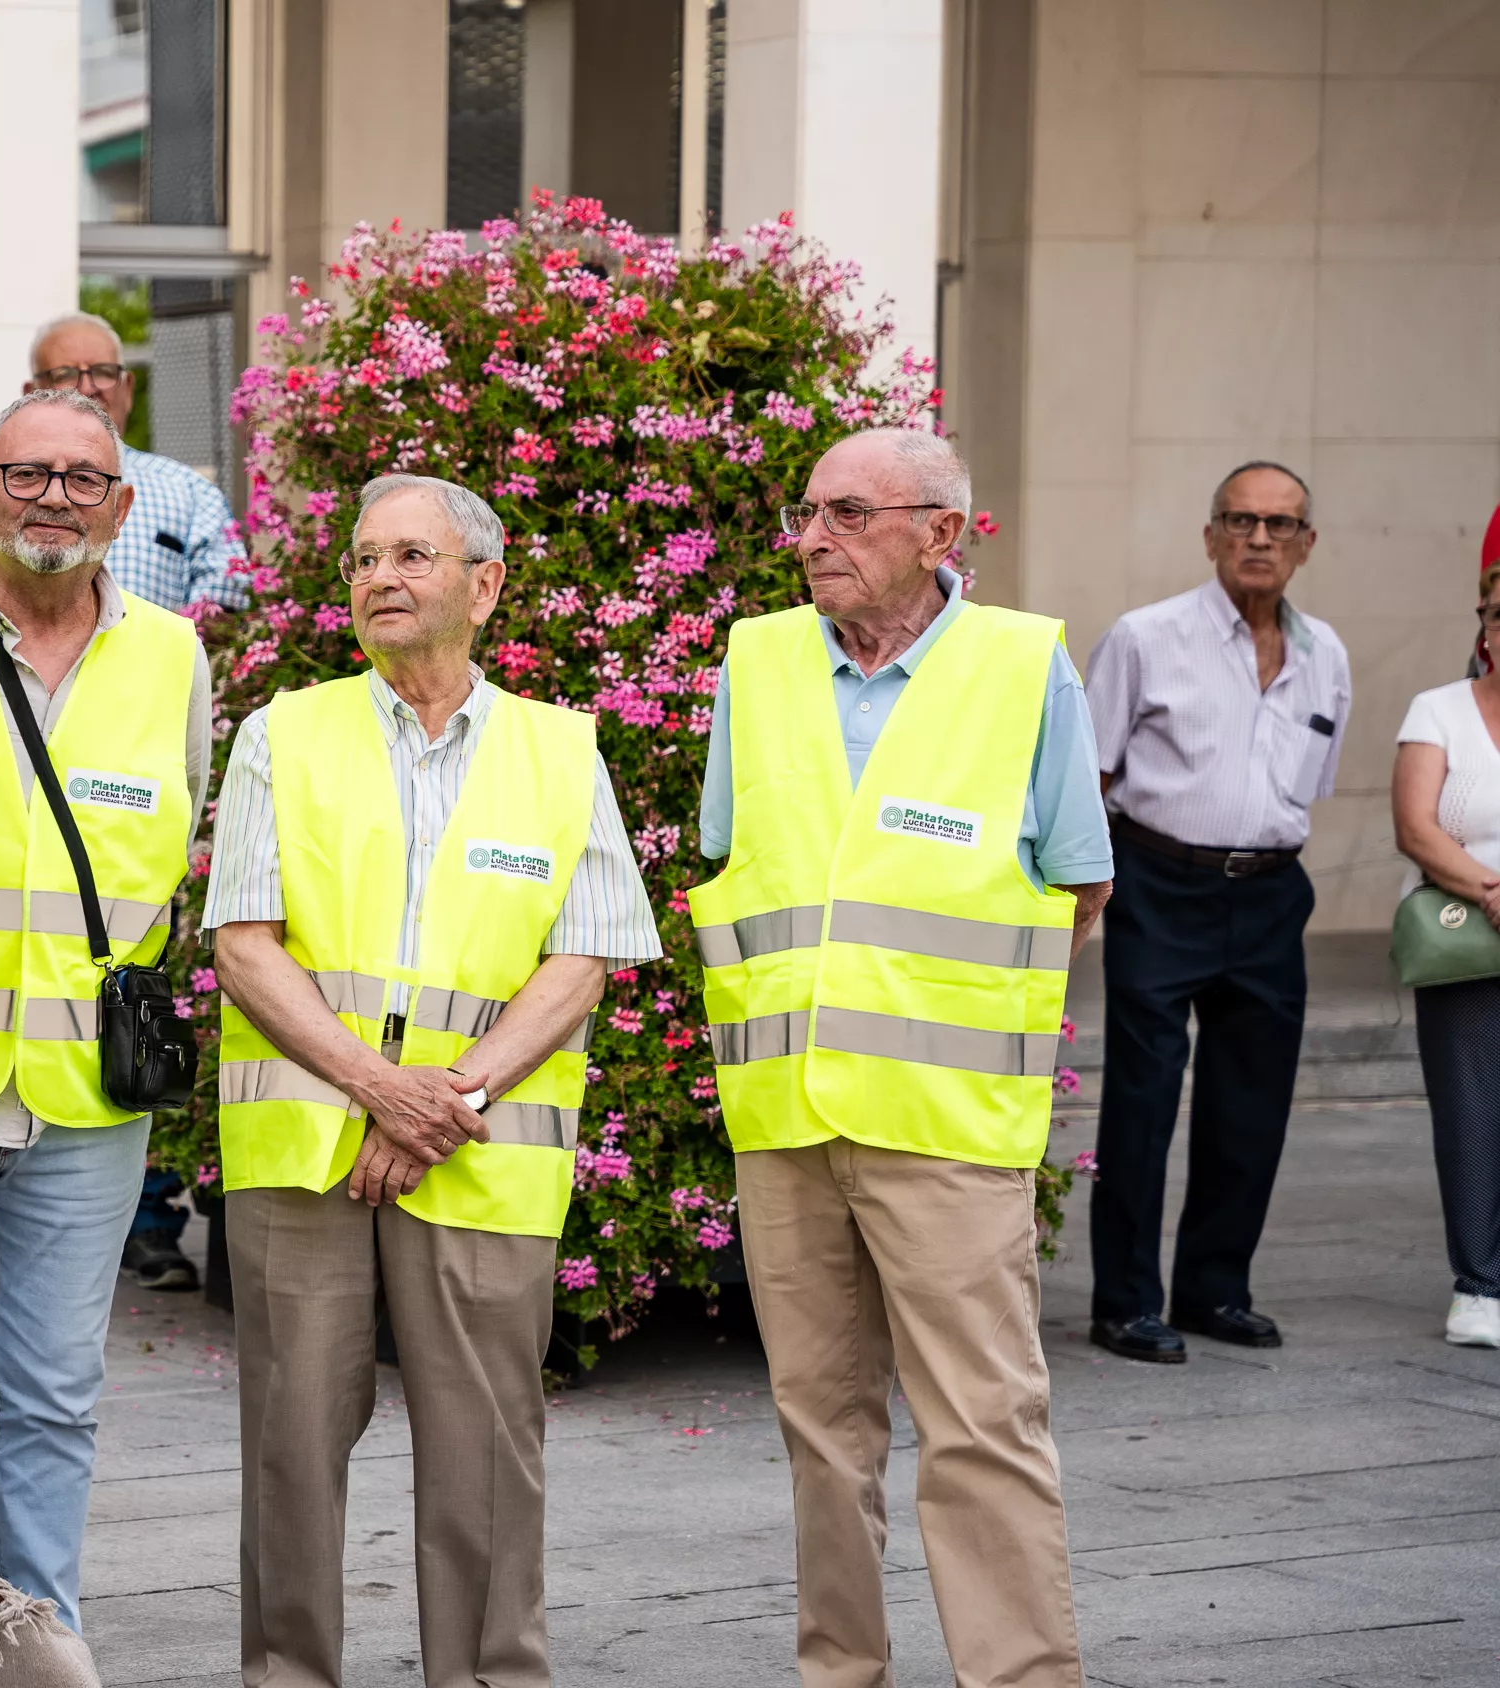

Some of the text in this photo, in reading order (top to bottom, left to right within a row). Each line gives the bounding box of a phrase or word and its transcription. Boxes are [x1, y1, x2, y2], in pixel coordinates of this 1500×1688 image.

[90, 790, 151, 804] LUCENA POR SUS
[91, 780, 152, 798] Plataforma
[903, 819, 972, 838] LUCENA POR SUS
[904, 808, 974, 831] Plataforma
[491, 848, 550, 868] Plataforma
[491, 858, 520, 868] LUCENA
[538, 867, 549, 875] SUS
